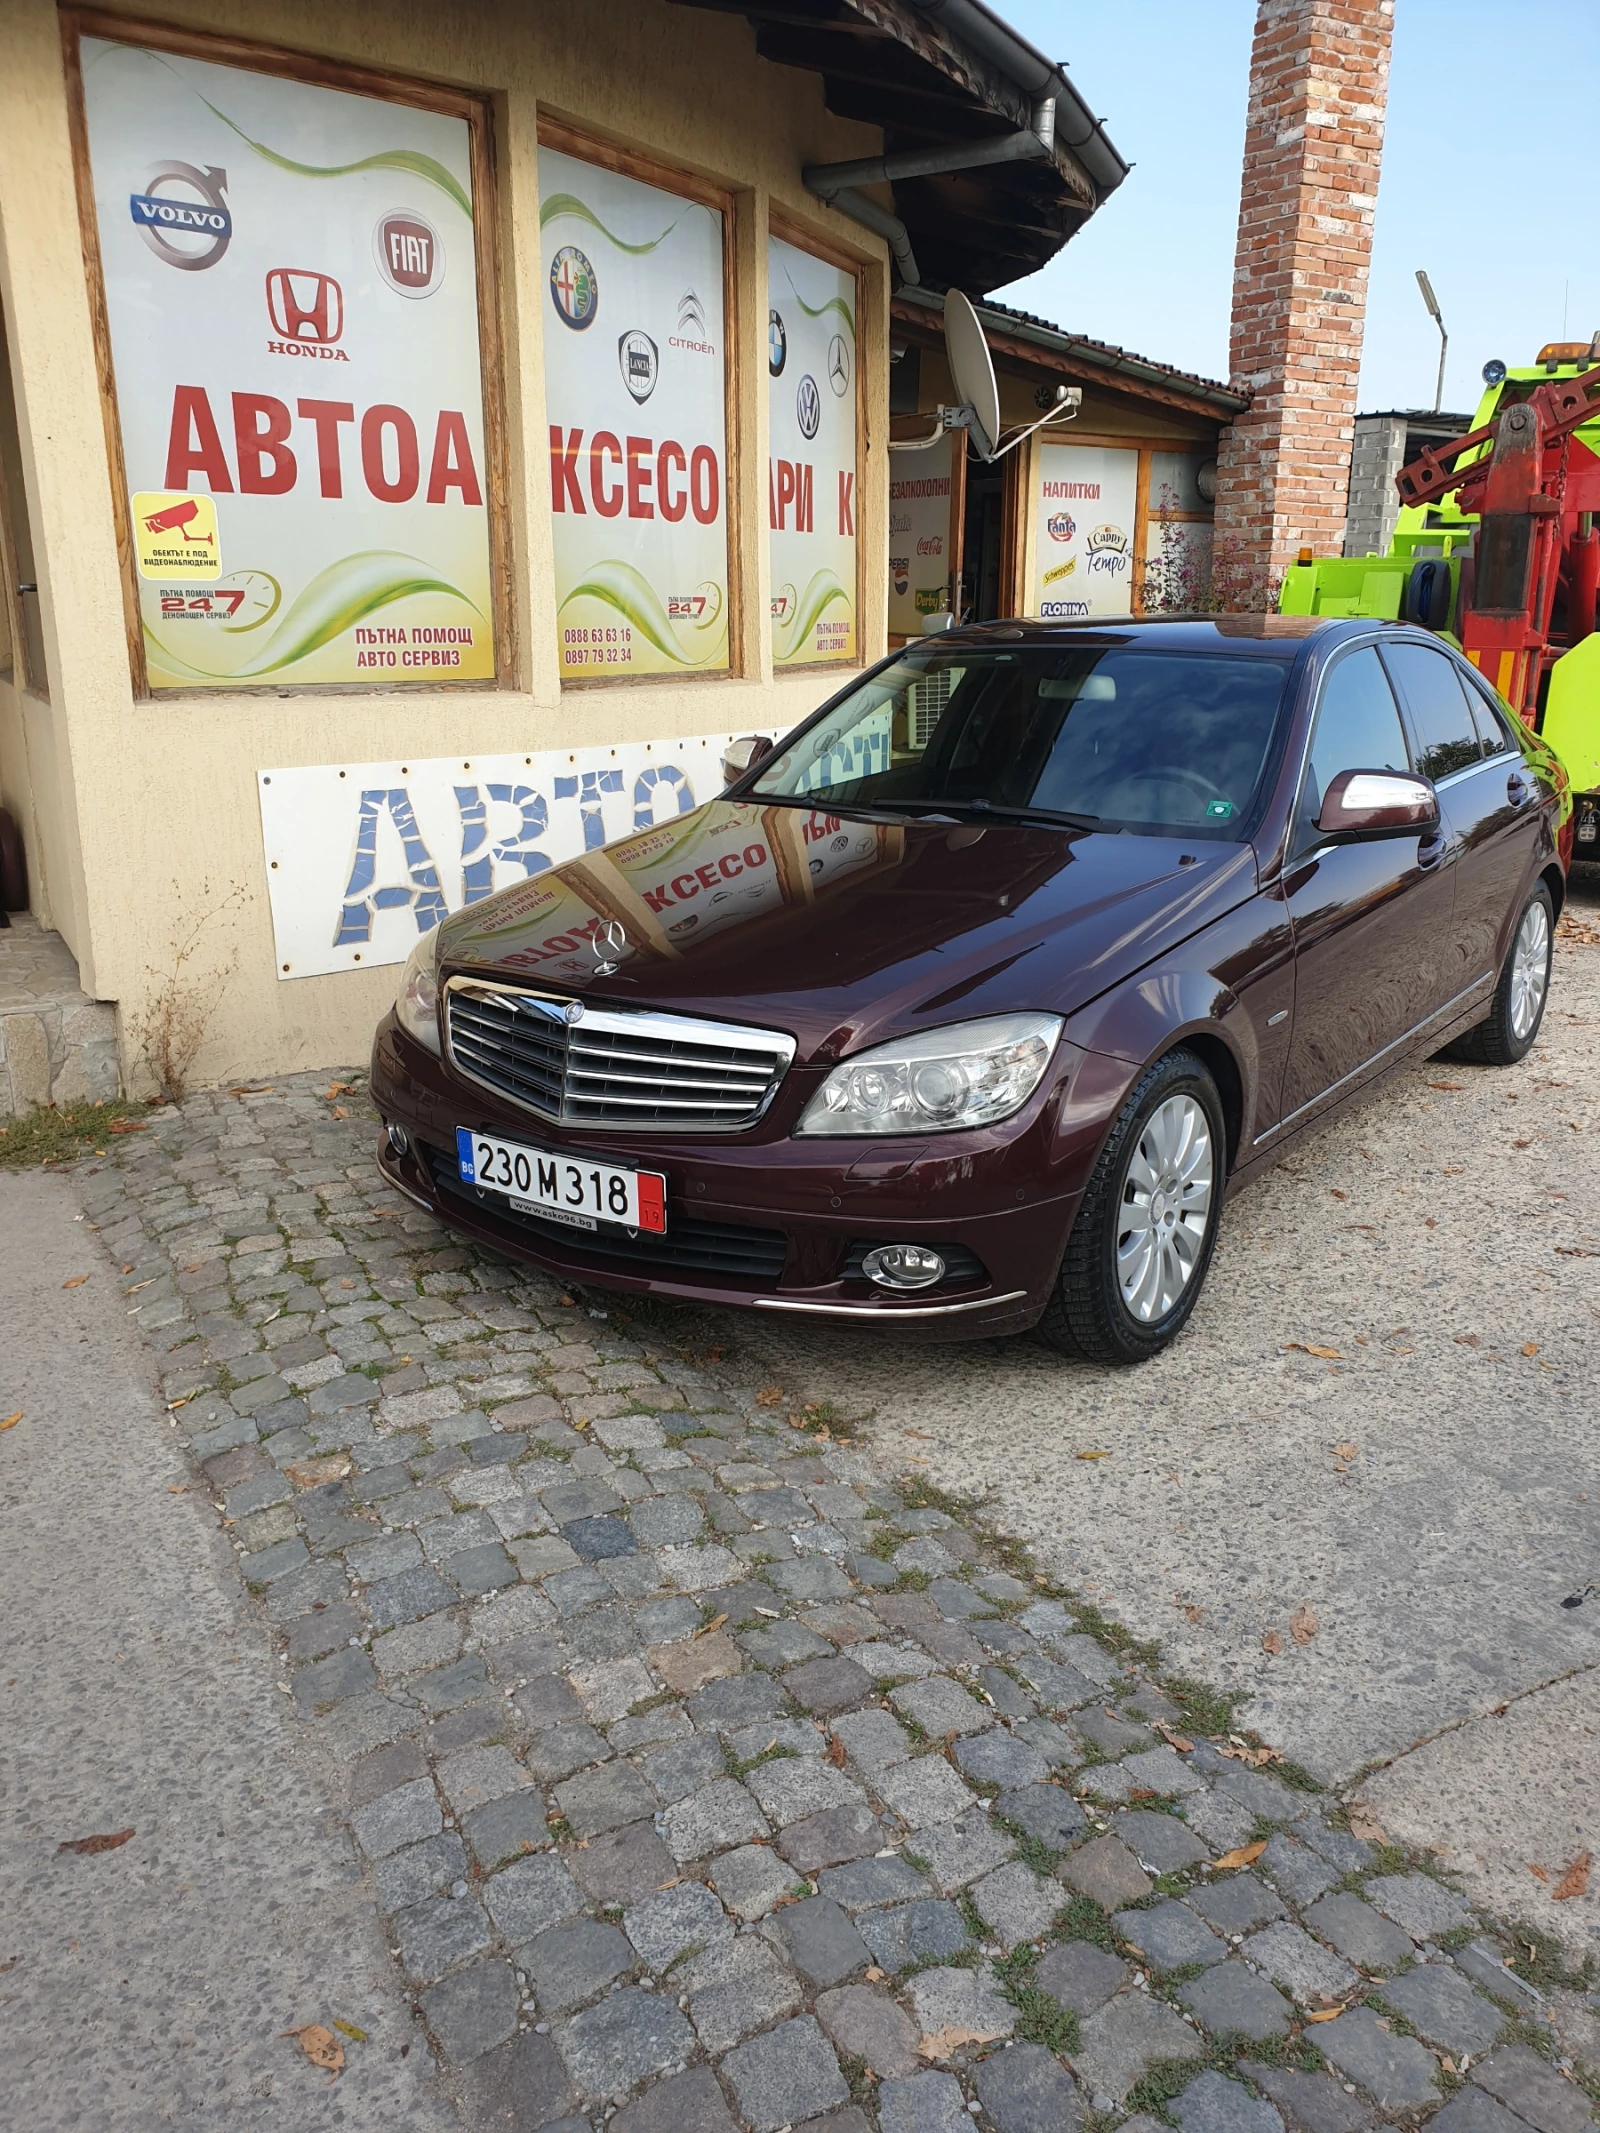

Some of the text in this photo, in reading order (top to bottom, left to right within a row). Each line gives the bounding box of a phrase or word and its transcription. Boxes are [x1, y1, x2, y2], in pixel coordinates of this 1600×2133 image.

[136, 201, 226, 231] VOLVO
[389, 233, 429, 275] FIAT
[267, 341, 350, 361] HONDA
[629, 357, 650, 371] LANCIA
[163, 384, 484, 507] АВТОА
[549, 424, 720, 525] КСЕСО
[1043, 481, 1100, 500] НАПИТКИ
[1047, 518, 1076, 534] Fanta
[1093, 532, 1123, 546] Cappy
[152, 549, 208, 558] ОБЕКТЪТ Е ПОД
[143, 558, 218, 567] ВИДЕОНАБЛЮДЕНИЕ
[1085, 546, 1126, 578] Tempo
[1044, 560, 1074, 584] Schweppes
[160, 589, 214, 599] ПЪТНА ПОМОЩ
[916, 593, 939, 611] Derby
[162, 611, 231, 620] ДЕНОНОЩЕН СЕРВИЗ
[1041, 602, 1088, 617] FLORINA
[355, 627, 473, 646] ПЪТНА ПОМОЩ
[564, 628, 631, 644] 0888 63 63 16
[357, 650, 461, 667] АВТО СЕРВИЗ
[565, 648, 632, 664] 0897 79 32 34
[461, 1161, 474, 1175] BG
[514, 1201, 593, 1229] www.asko96.bg
[643, 1209, 660, 1225] 19
